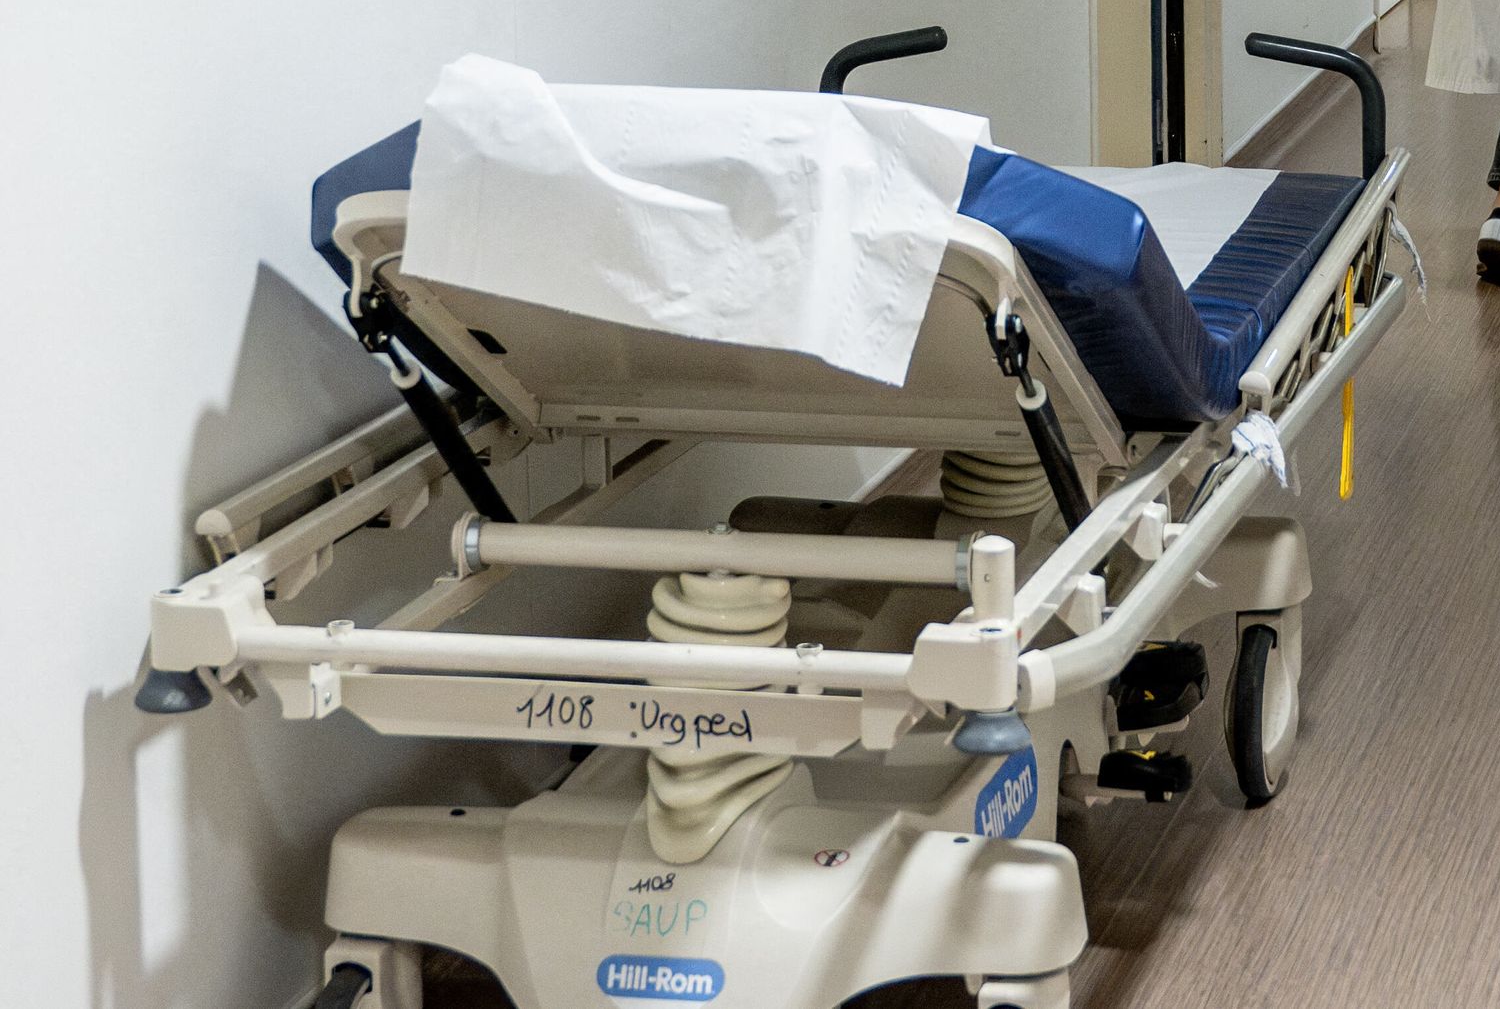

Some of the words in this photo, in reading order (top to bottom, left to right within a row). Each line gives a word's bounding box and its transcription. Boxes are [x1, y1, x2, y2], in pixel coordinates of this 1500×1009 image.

[517, 693, 595, 729] 1108
[693, 709, 753, 749] ped
[981, 764, 1034, 838] Hill-Rom
[628, 872, 677, 893] 1108
[606, 963, 714, 995] Hill-Rom
